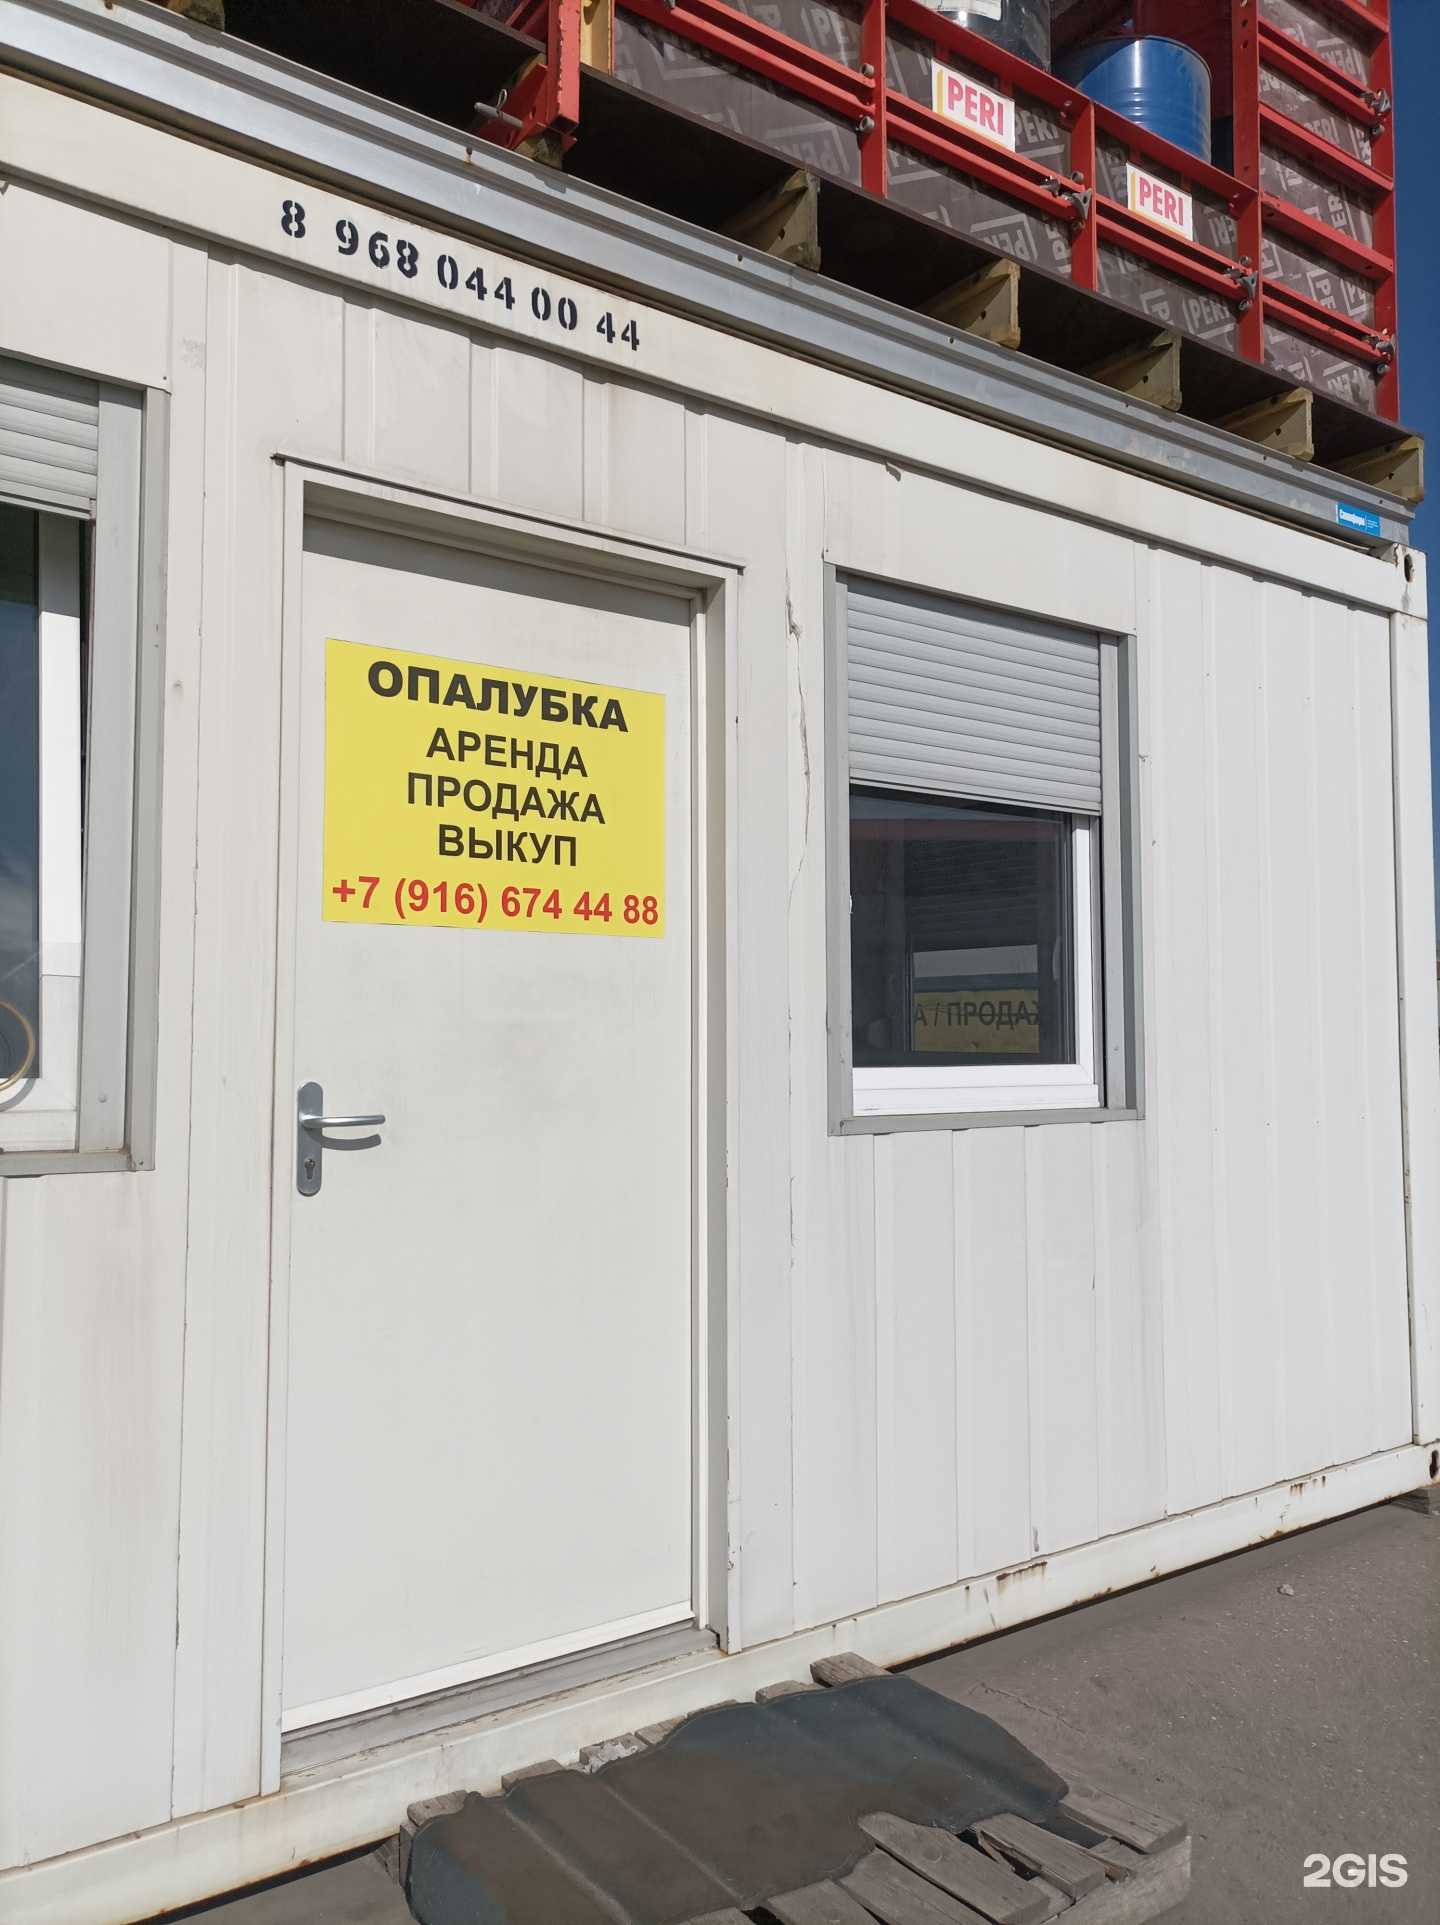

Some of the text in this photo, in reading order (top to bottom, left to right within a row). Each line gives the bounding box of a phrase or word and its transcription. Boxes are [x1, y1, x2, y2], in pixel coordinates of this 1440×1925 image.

[947, 76, 1004, 136] PERI
[1139, 177, 1184, 226] PERI
[281, 199, 640, 351] 8 968 044 00 44
[367, 660, 629, 732] ОПАЛУБКА
[425, 727, 588, 780] АРЕНДА
[407, 772, 606, 825] ПРОДАЖА
[438, 823, 577, 867] ВЫКУП
[332, 876, 659, 926] +7 (916) 674 44 88
